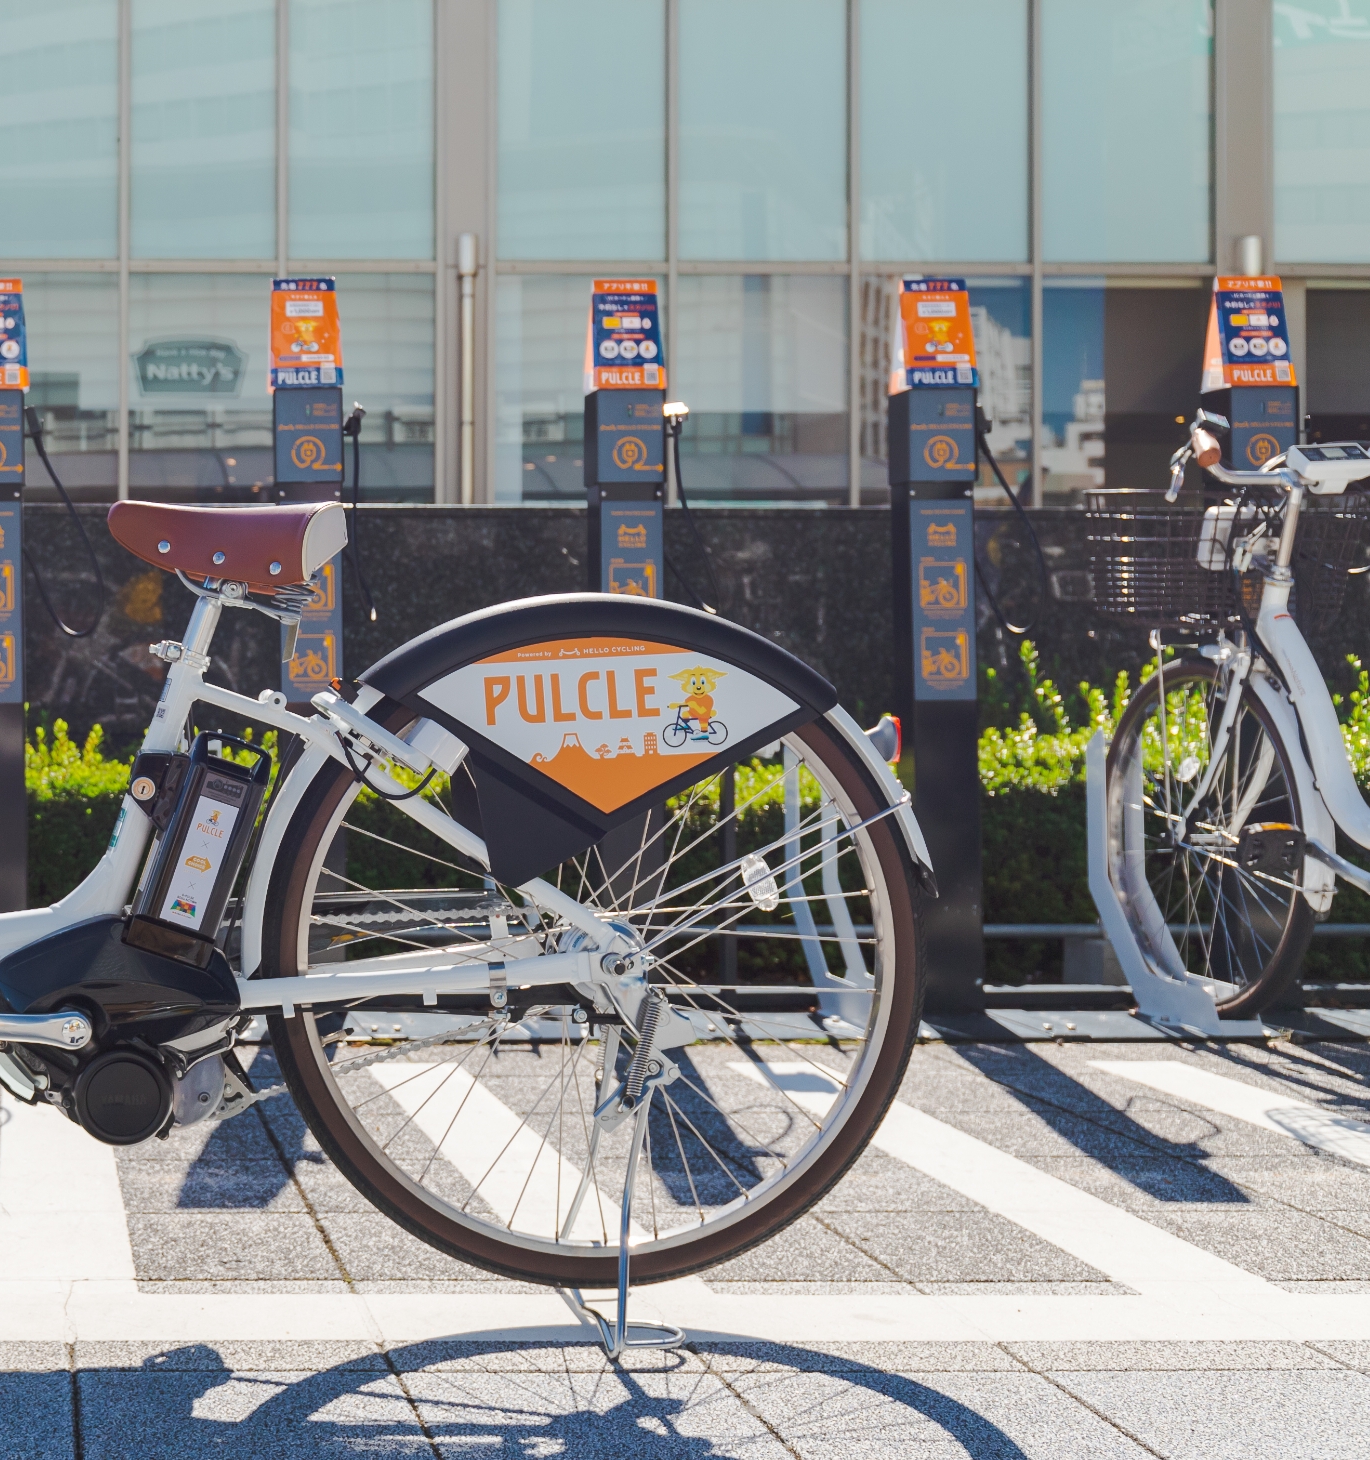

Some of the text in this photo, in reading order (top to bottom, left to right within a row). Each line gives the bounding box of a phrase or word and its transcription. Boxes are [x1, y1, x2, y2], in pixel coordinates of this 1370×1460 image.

[146, 361, 234, 386] Natty's
[277, 371, 319, 385] PULCLE
[601, 371, 642, 385] PULCLE
[913, 370, 955, 384] PULCLE
[1232, 369, 1273, 382] PULCLE
[611, 645, 646, 653] CYCLING
[483, 667, 661, 727] PULCLE
[196, 822, 225, 839] PULCLE
